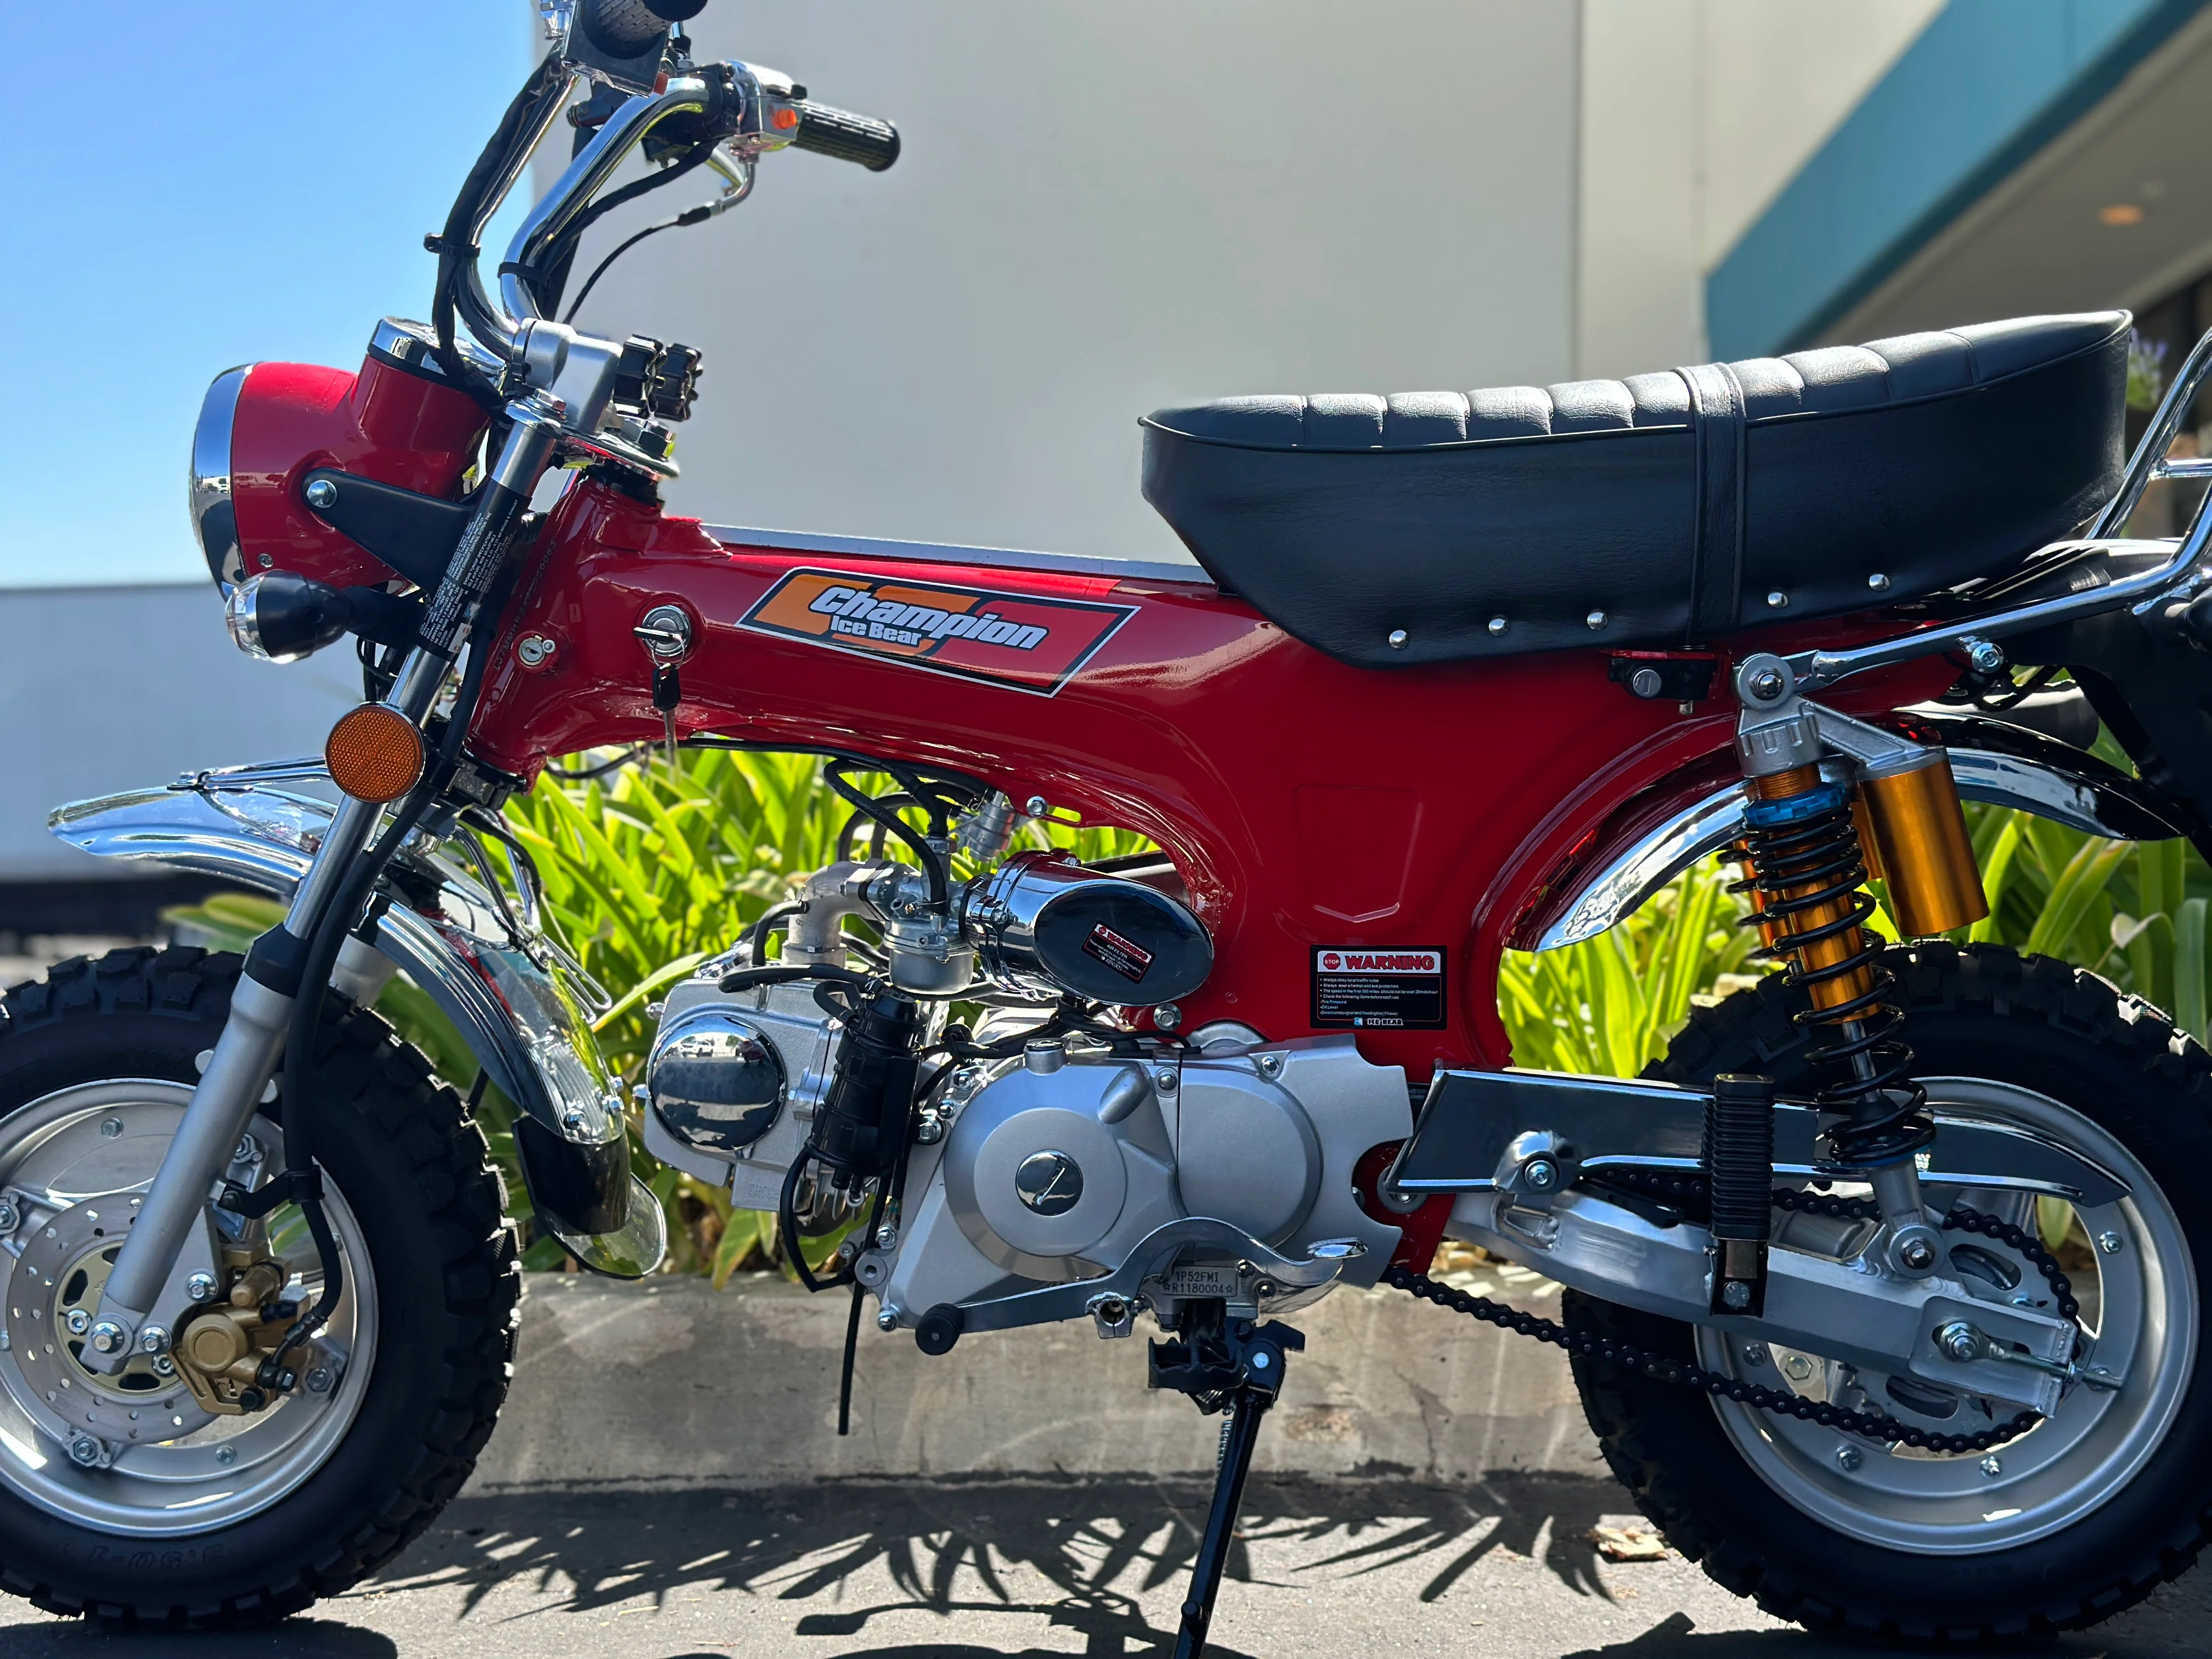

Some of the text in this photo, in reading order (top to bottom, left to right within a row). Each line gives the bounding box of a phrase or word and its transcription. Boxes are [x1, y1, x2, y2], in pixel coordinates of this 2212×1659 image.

[810, 587, 1047, 650] Champion
[832, 615, 922, 646] Ice Bear
[1114, 949, 1128, 959] FILTER
[1345, 955, 1435, 970] WARNING
[1176, 1272, 1219, 1282] 1P52FMI
[1172, 1284, 1224, 1293] R1180004
